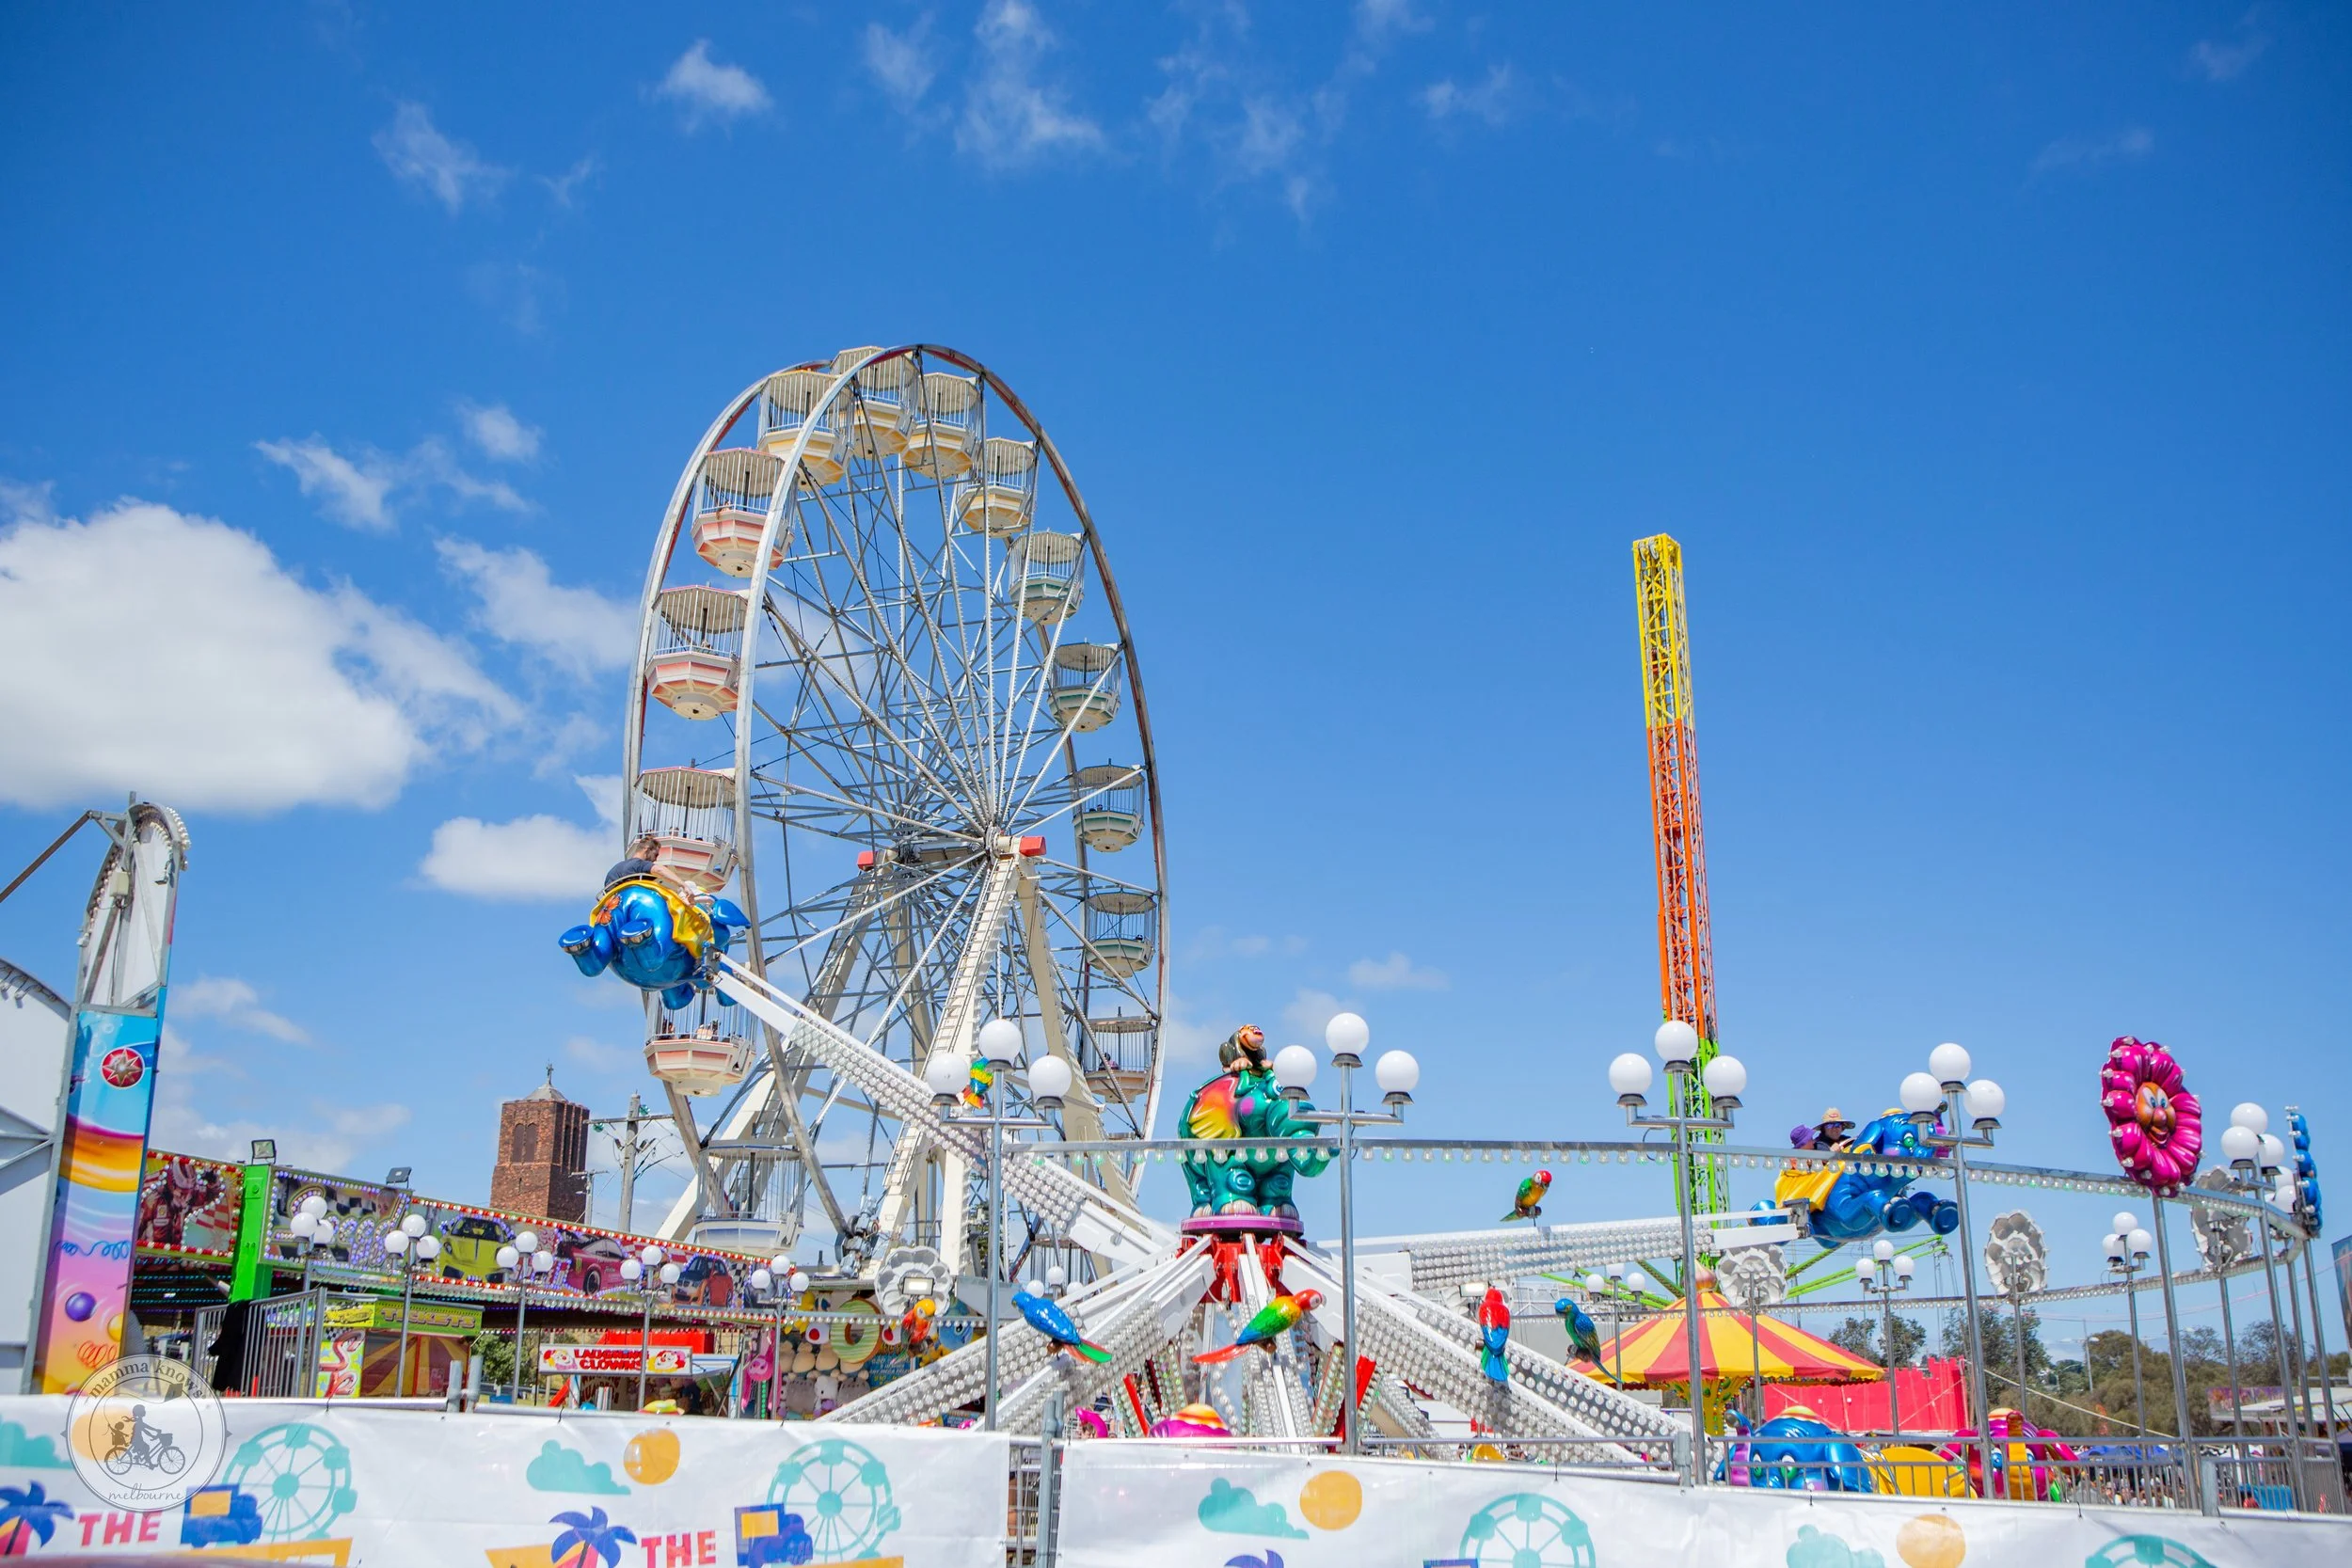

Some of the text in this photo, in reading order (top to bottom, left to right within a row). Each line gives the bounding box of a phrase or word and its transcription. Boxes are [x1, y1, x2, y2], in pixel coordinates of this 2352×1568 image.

[580, 1357, 643, 1370] CLOWNS
[78, 1510, 163, 1547] THE
[641, 1529, 717, 1568] THE
